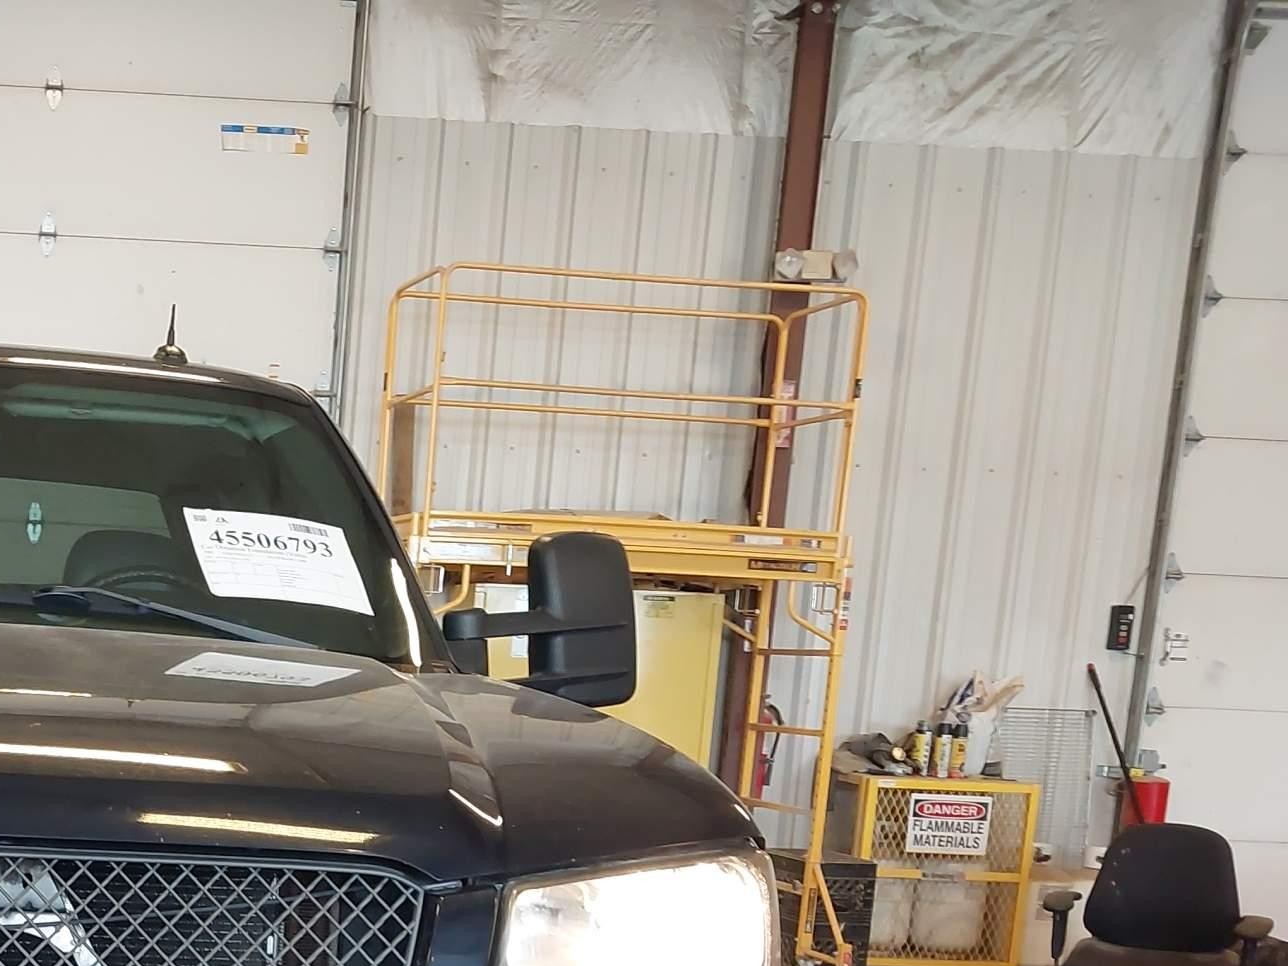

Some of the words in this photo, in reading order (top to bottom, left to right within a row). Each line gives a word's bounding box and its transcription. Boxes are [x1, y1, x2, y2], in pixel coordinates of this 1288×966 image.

[208, 528, 334, 558] 45506793
[922, 803, 978, 817] DANGER
[912, 818, 985, 835] FLAMMABLE
[912, 833, 981, 850] MATERIALS
